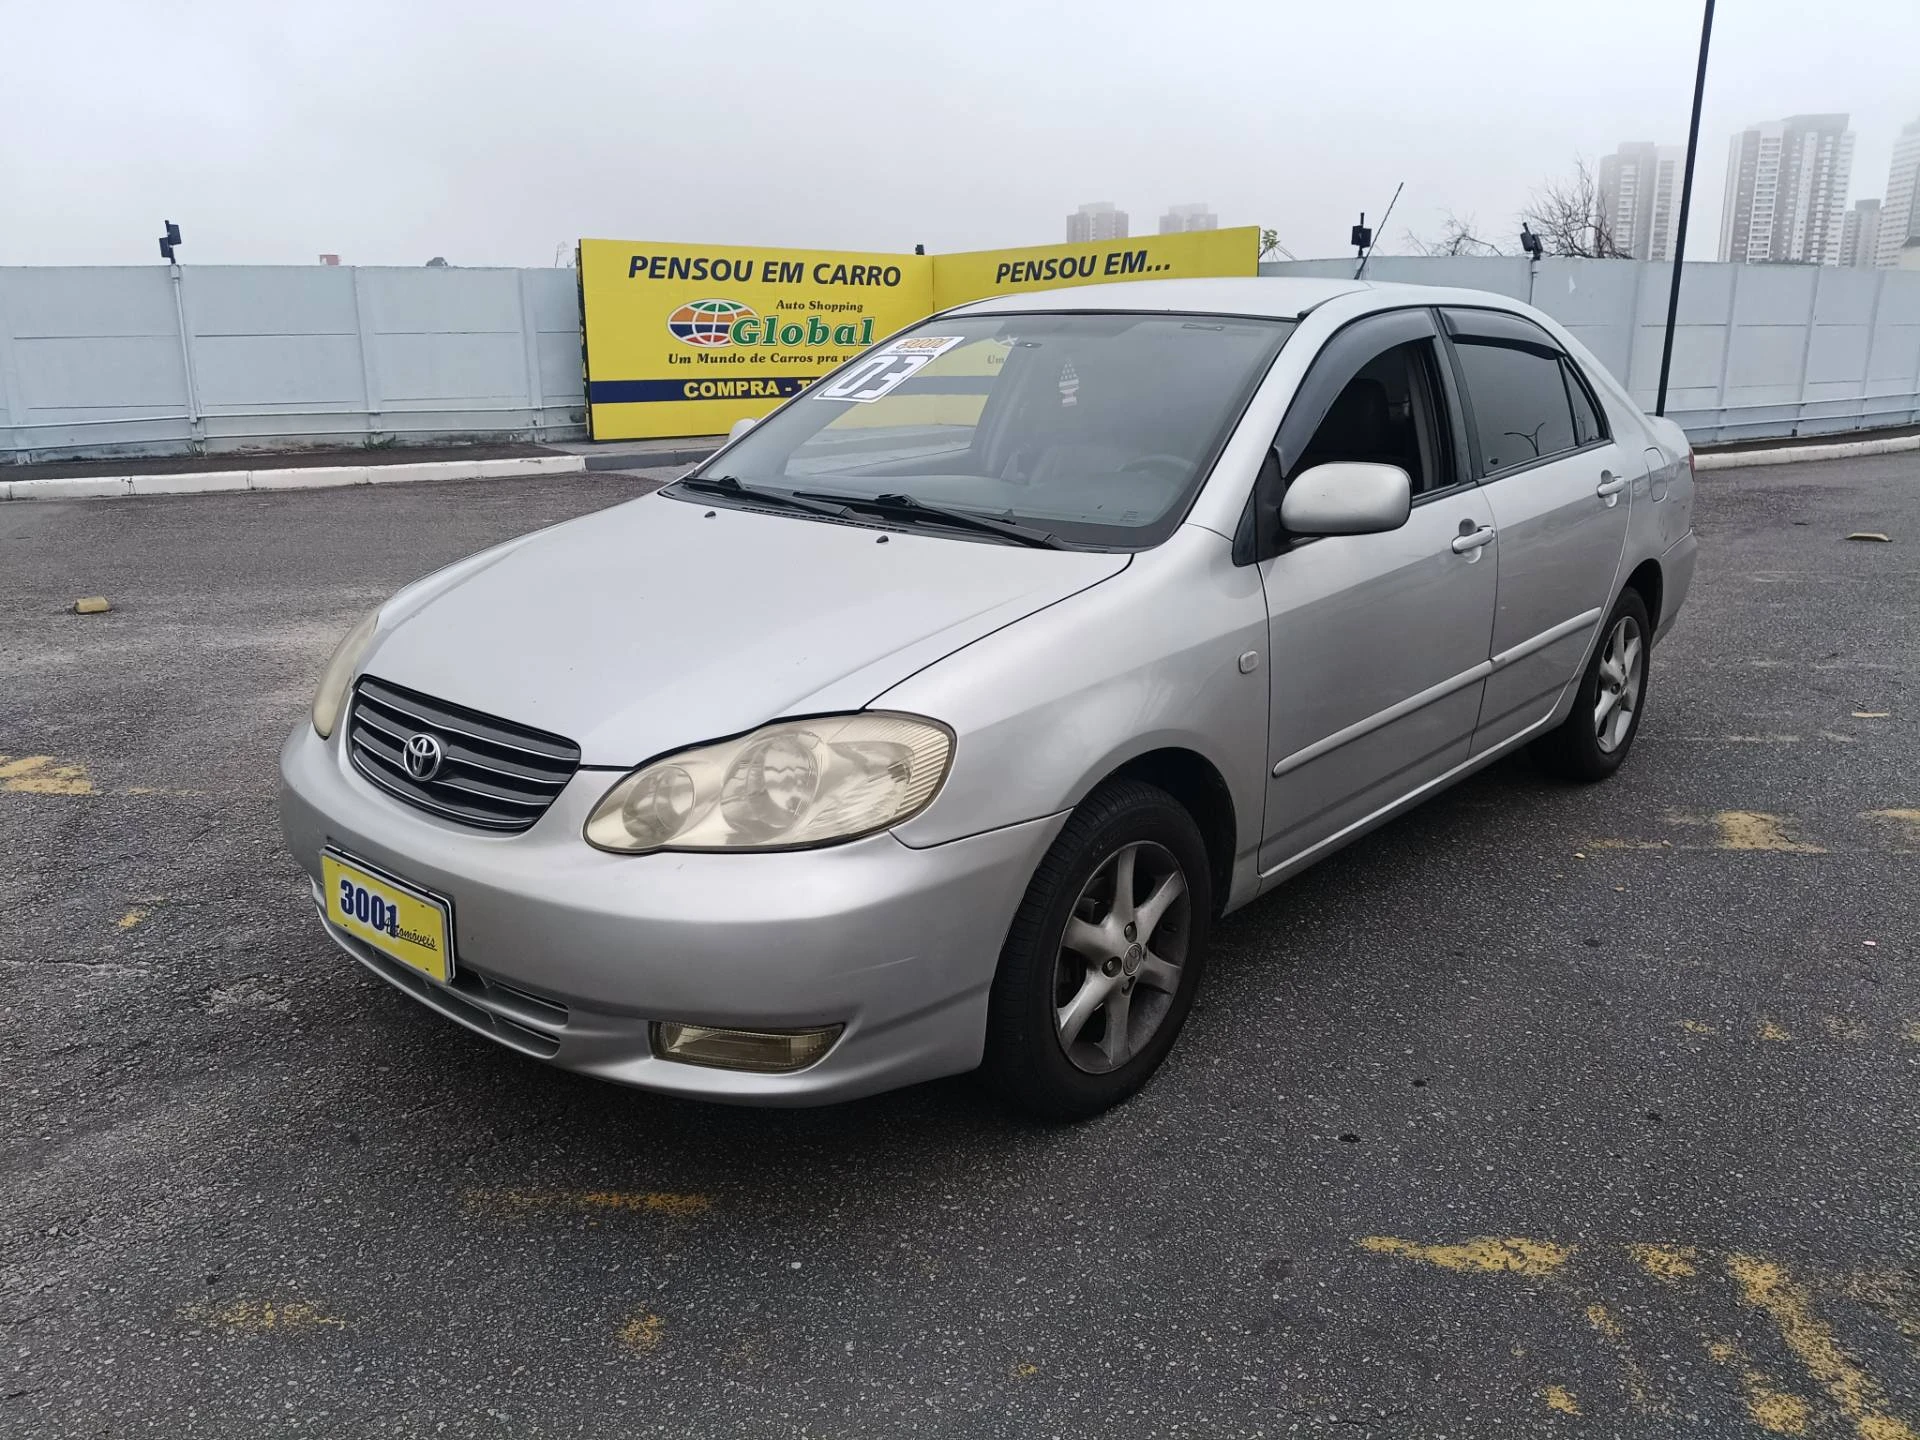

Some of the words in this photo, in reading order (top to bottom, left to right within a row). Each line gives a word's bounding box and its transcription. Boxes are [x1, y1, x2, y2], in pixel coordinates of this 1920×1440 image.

[628, 255, 754, 283] PENSOU
[762, 261, 806, 284] EM
[813, 262, 902, 287] CARRO
[996, 254, 1098, 284] PENSOU
[1104, 250, 1171, 276] EM...
[776, 299, 805, 311] Auto
[809, 300, 864, 314] Shopping
[730, 314, 875, 347] Global
[668, 353, 692, 365] Um
[696, 352, 746, 364] Mundo
[749, 353, 766, 363] de
[770, 352, 814, 363] Carros
[816, 354, 839, 365] pra
[683, 380, 781, 398] COMPRA
[822, 355, 930, 399] 03
[340, 879, 397, 939] 3001
